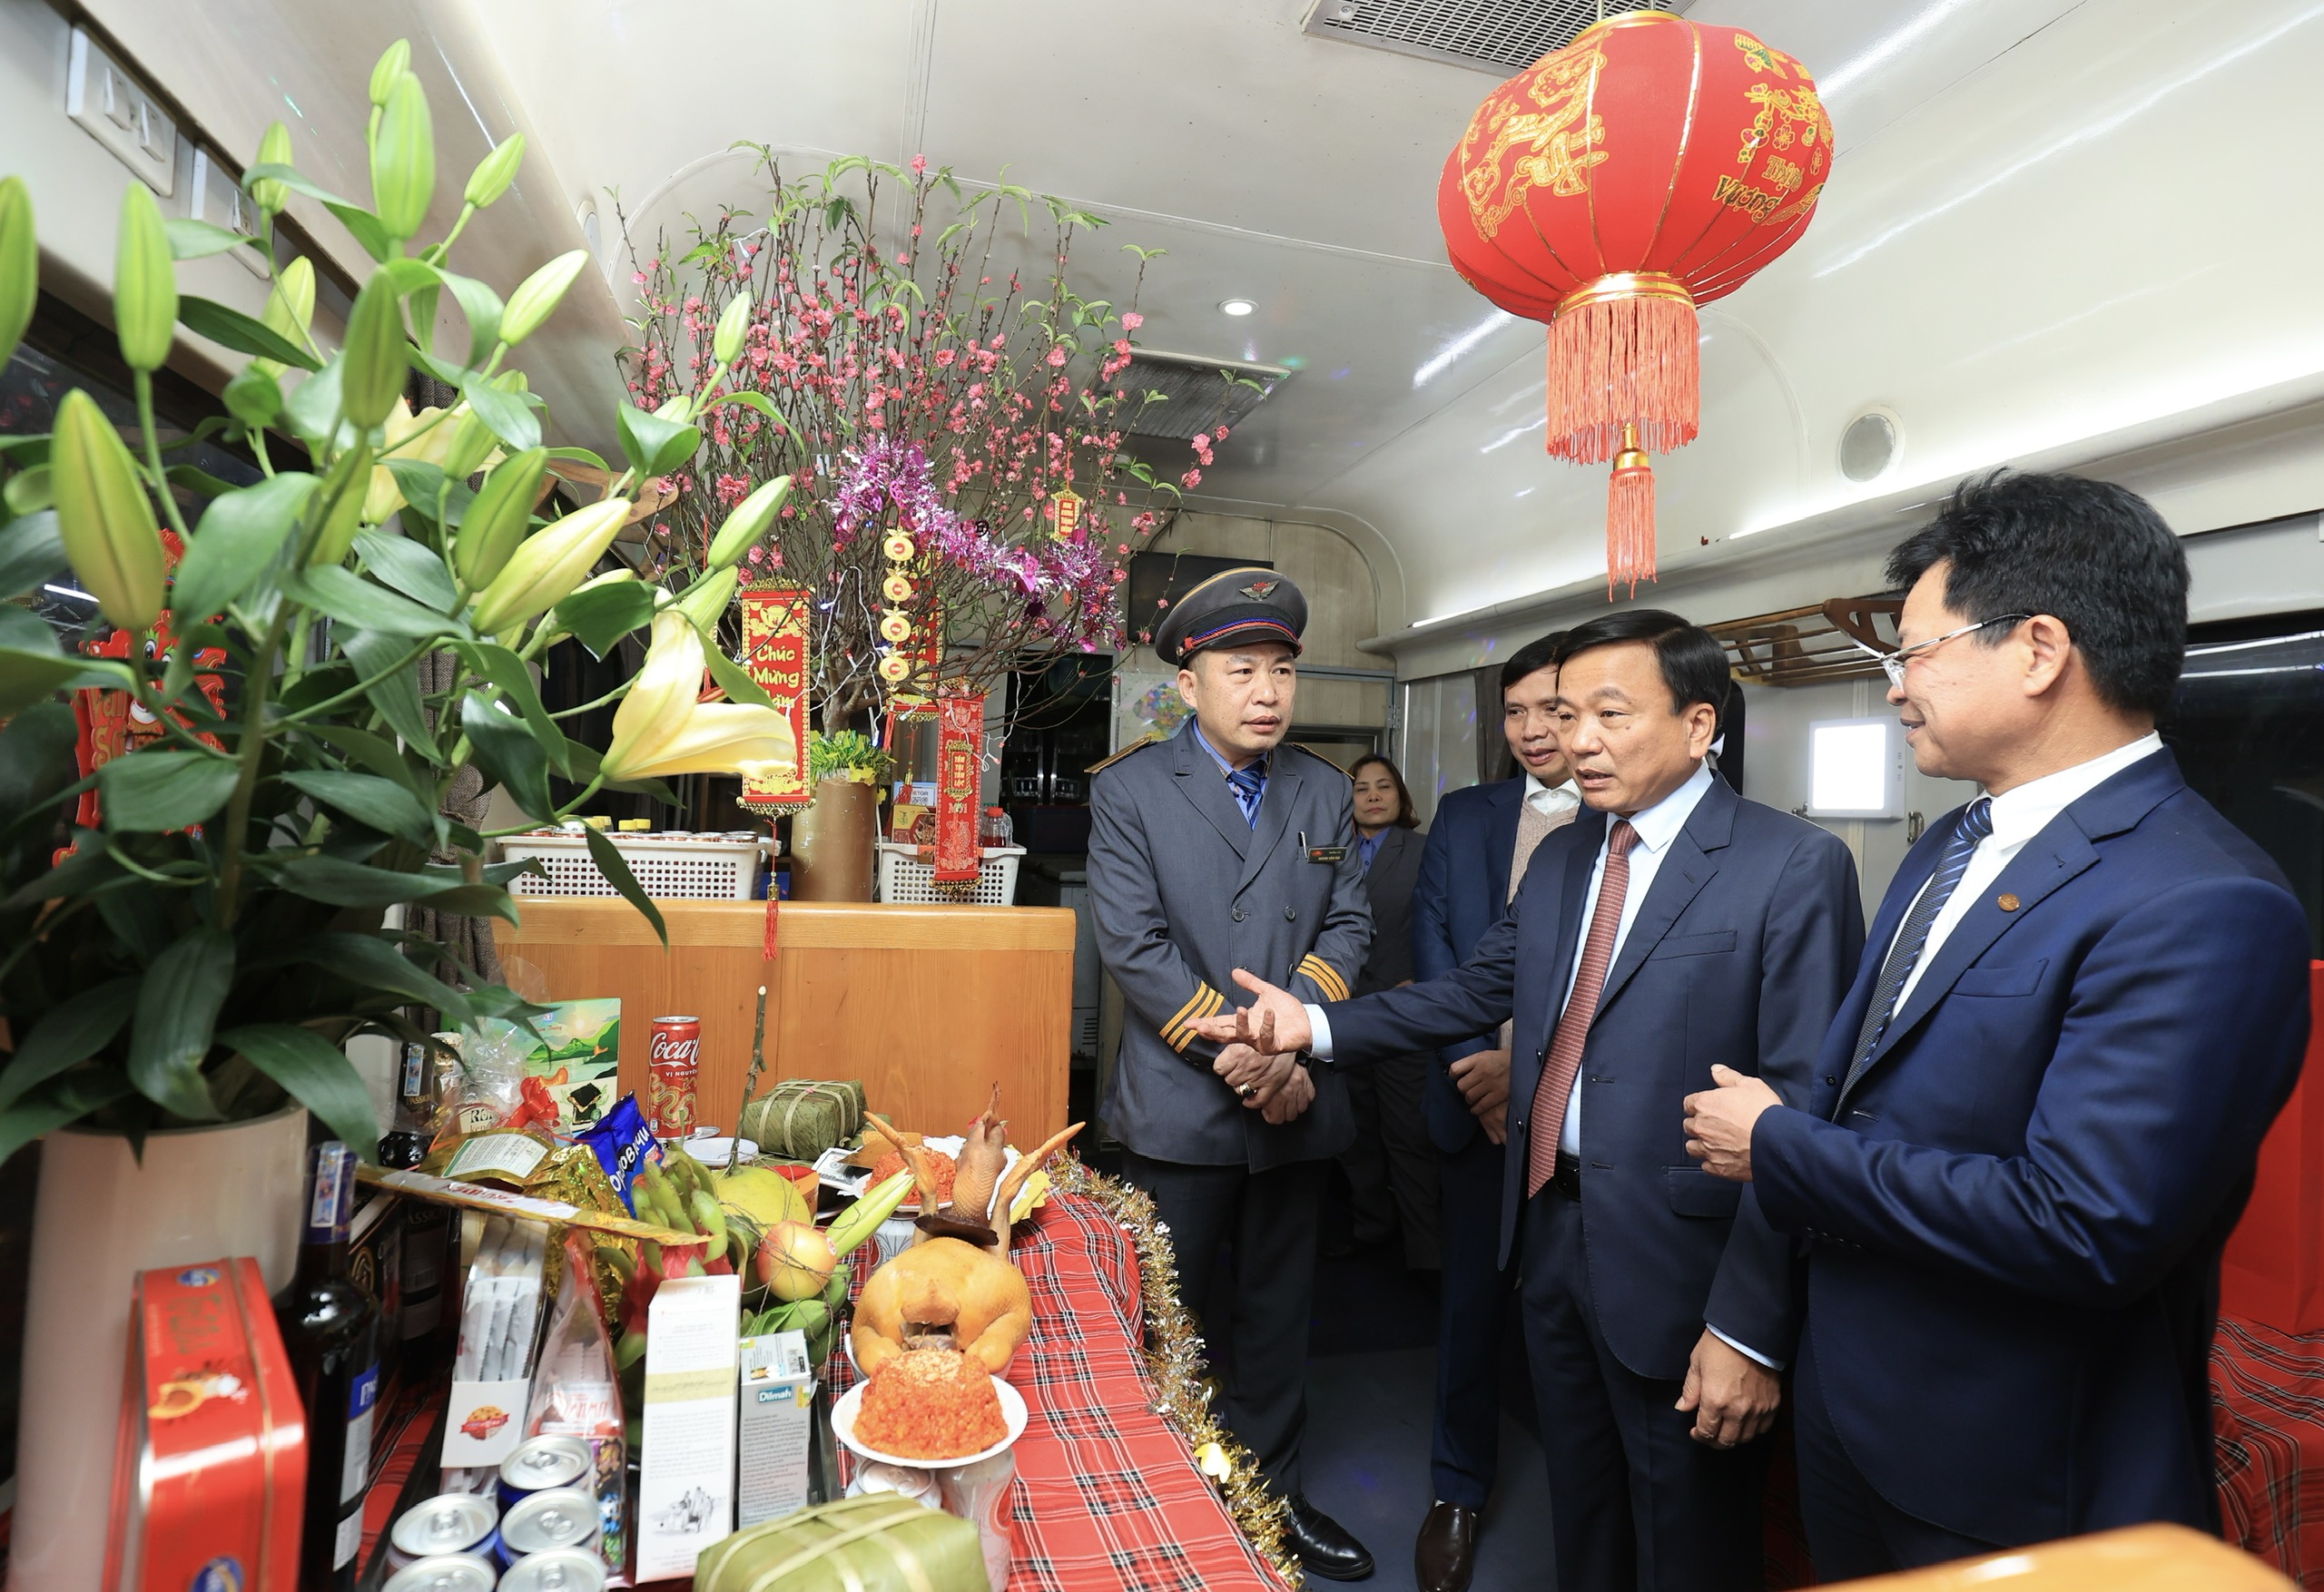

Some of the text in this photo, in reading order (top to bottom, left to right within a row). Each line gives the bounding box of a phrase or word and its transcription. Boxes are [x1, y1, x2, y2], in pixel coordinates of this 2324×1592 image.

[1712, 174, 1781, 223] Vượng
[756, 644, 795, 663] Chúc
[753, 666, 800, 688] Mừng
[758, 1387, 792, 1403] Dilmah
